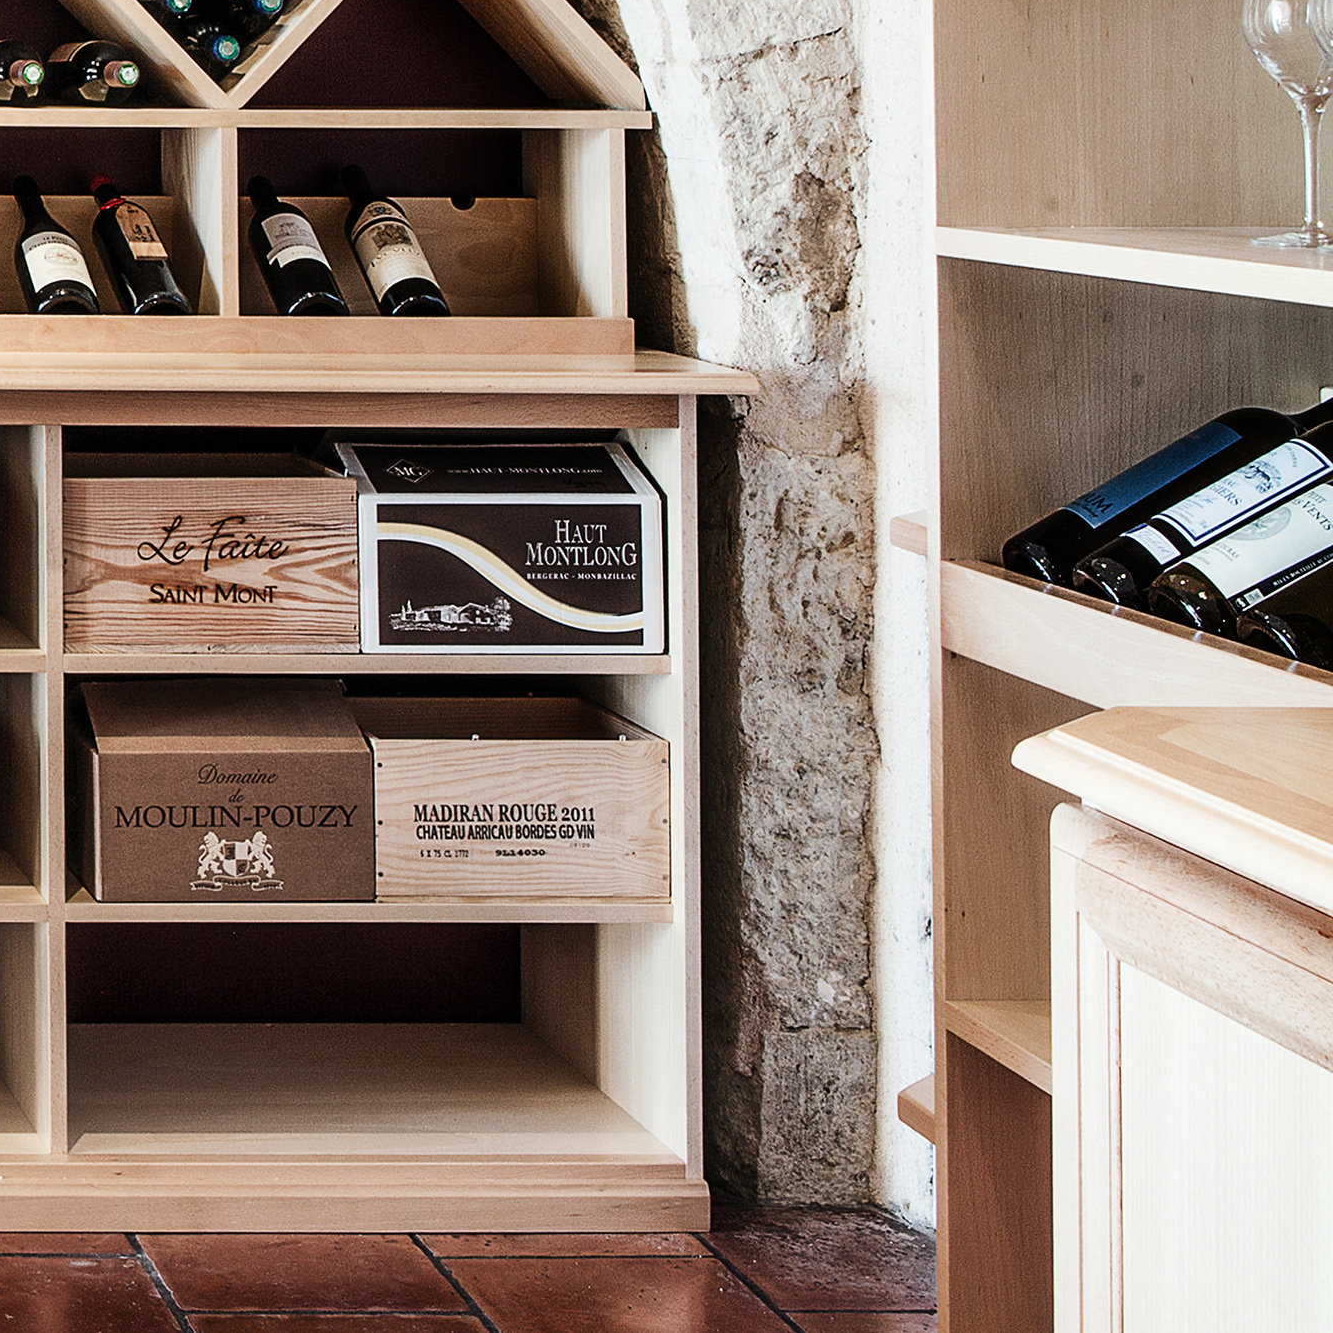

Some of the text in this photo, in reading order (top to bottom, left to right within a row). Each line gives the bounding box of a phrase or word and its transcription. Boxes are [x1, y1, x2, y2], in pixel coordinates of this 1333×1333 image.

[554, 519, 607, 544] HAUT
[137, 515, 290, 572] Le Faîte
[525, 542, 638, 566] MONTLONG
[197, 763, 279, 785] Domaine
[228, 788, 245, 803] de
[114, 805, 358, 828] MOULIN-POUZY
[413, 804, 595, 822] MADIRAN ROUGE 2011
[416, 825, 595, 840] CHATEAU ARRICAU BORDES GD VIN
